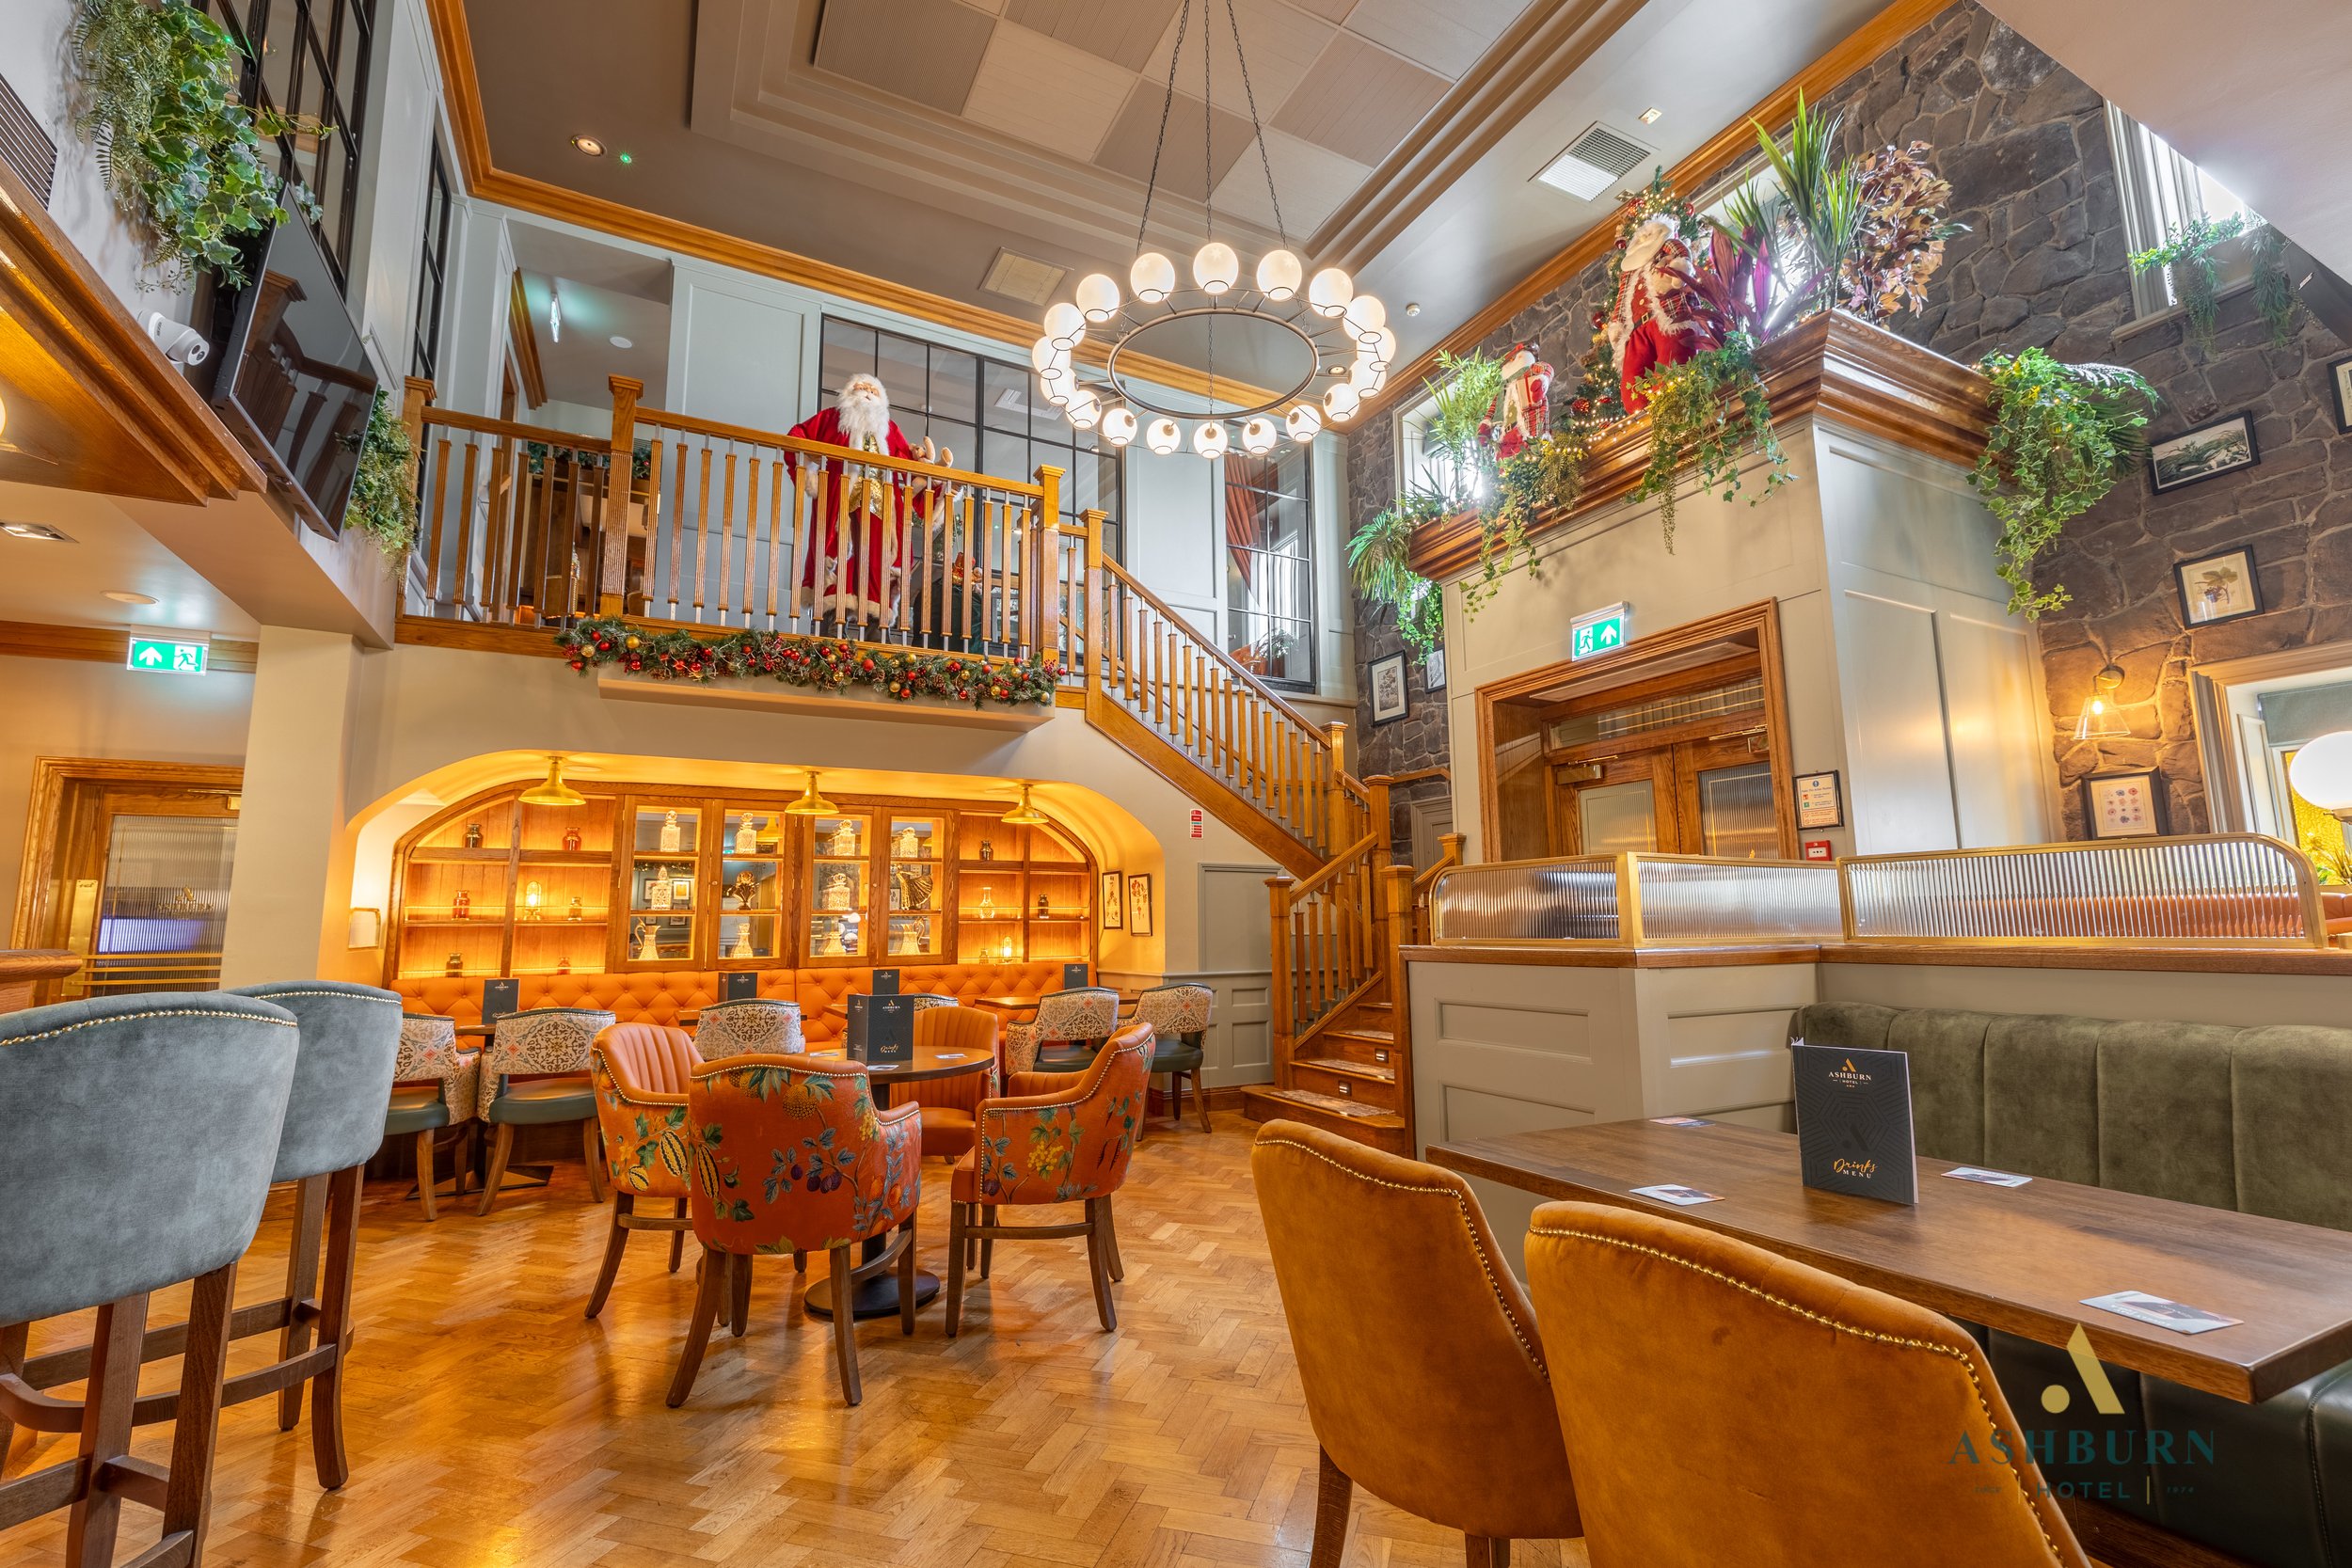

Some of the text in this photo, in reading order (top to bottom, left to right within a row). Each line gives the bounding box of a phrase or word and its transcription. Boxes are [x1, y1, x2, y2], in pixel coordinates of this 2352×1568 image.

[1828, 1071, 1872, 1081] ASHBURN
[1834, 1158, 1877, 1173] Drinks
[1842, 1169, 1871, 1179] MENU
